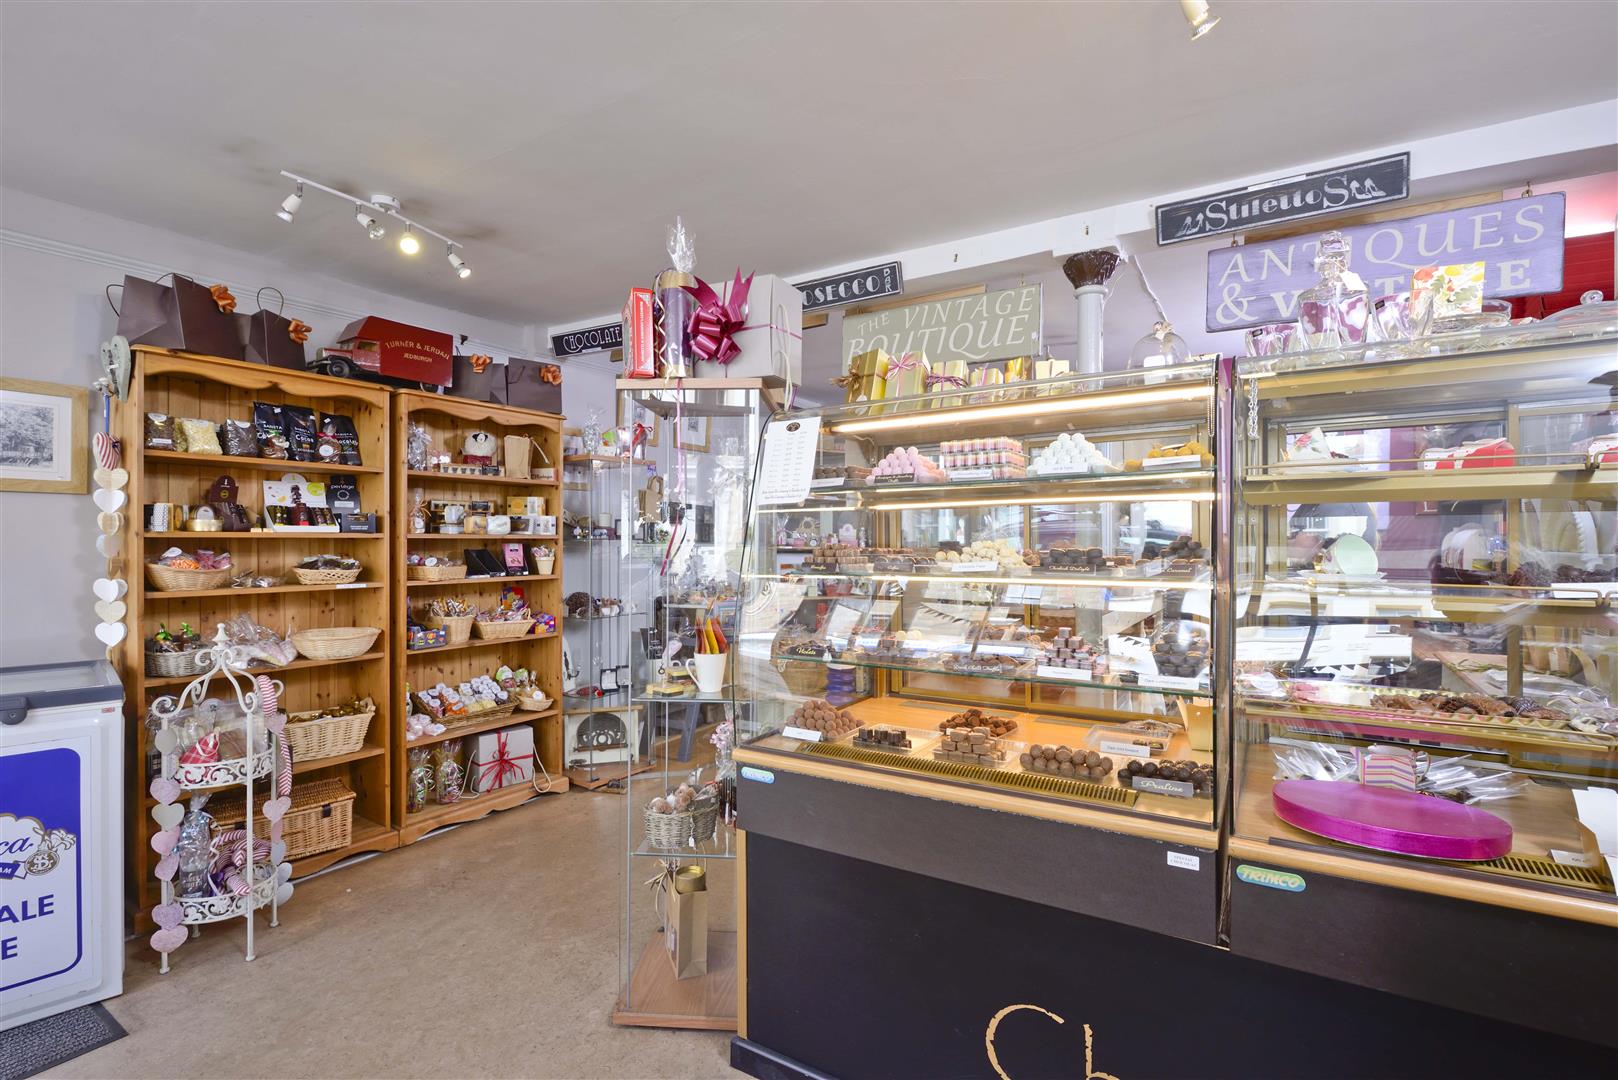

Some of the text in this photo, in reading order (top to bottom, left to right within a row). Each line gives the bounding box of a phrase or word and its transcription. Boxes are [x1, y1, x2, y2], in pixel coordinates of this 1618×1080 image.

[802, 274, 881, 306] OSECCO
[858, 287, 1036, 337] THE VINTAGE
[385, 340, 415, 350] TURNER
[562, 326, 622, 353] CHOCOLATE
[848, 315, 1030, 365] BOUTIQUE
[1139, 780, 1184, 793] Praline
[0, 893, 54, 924] ALE
